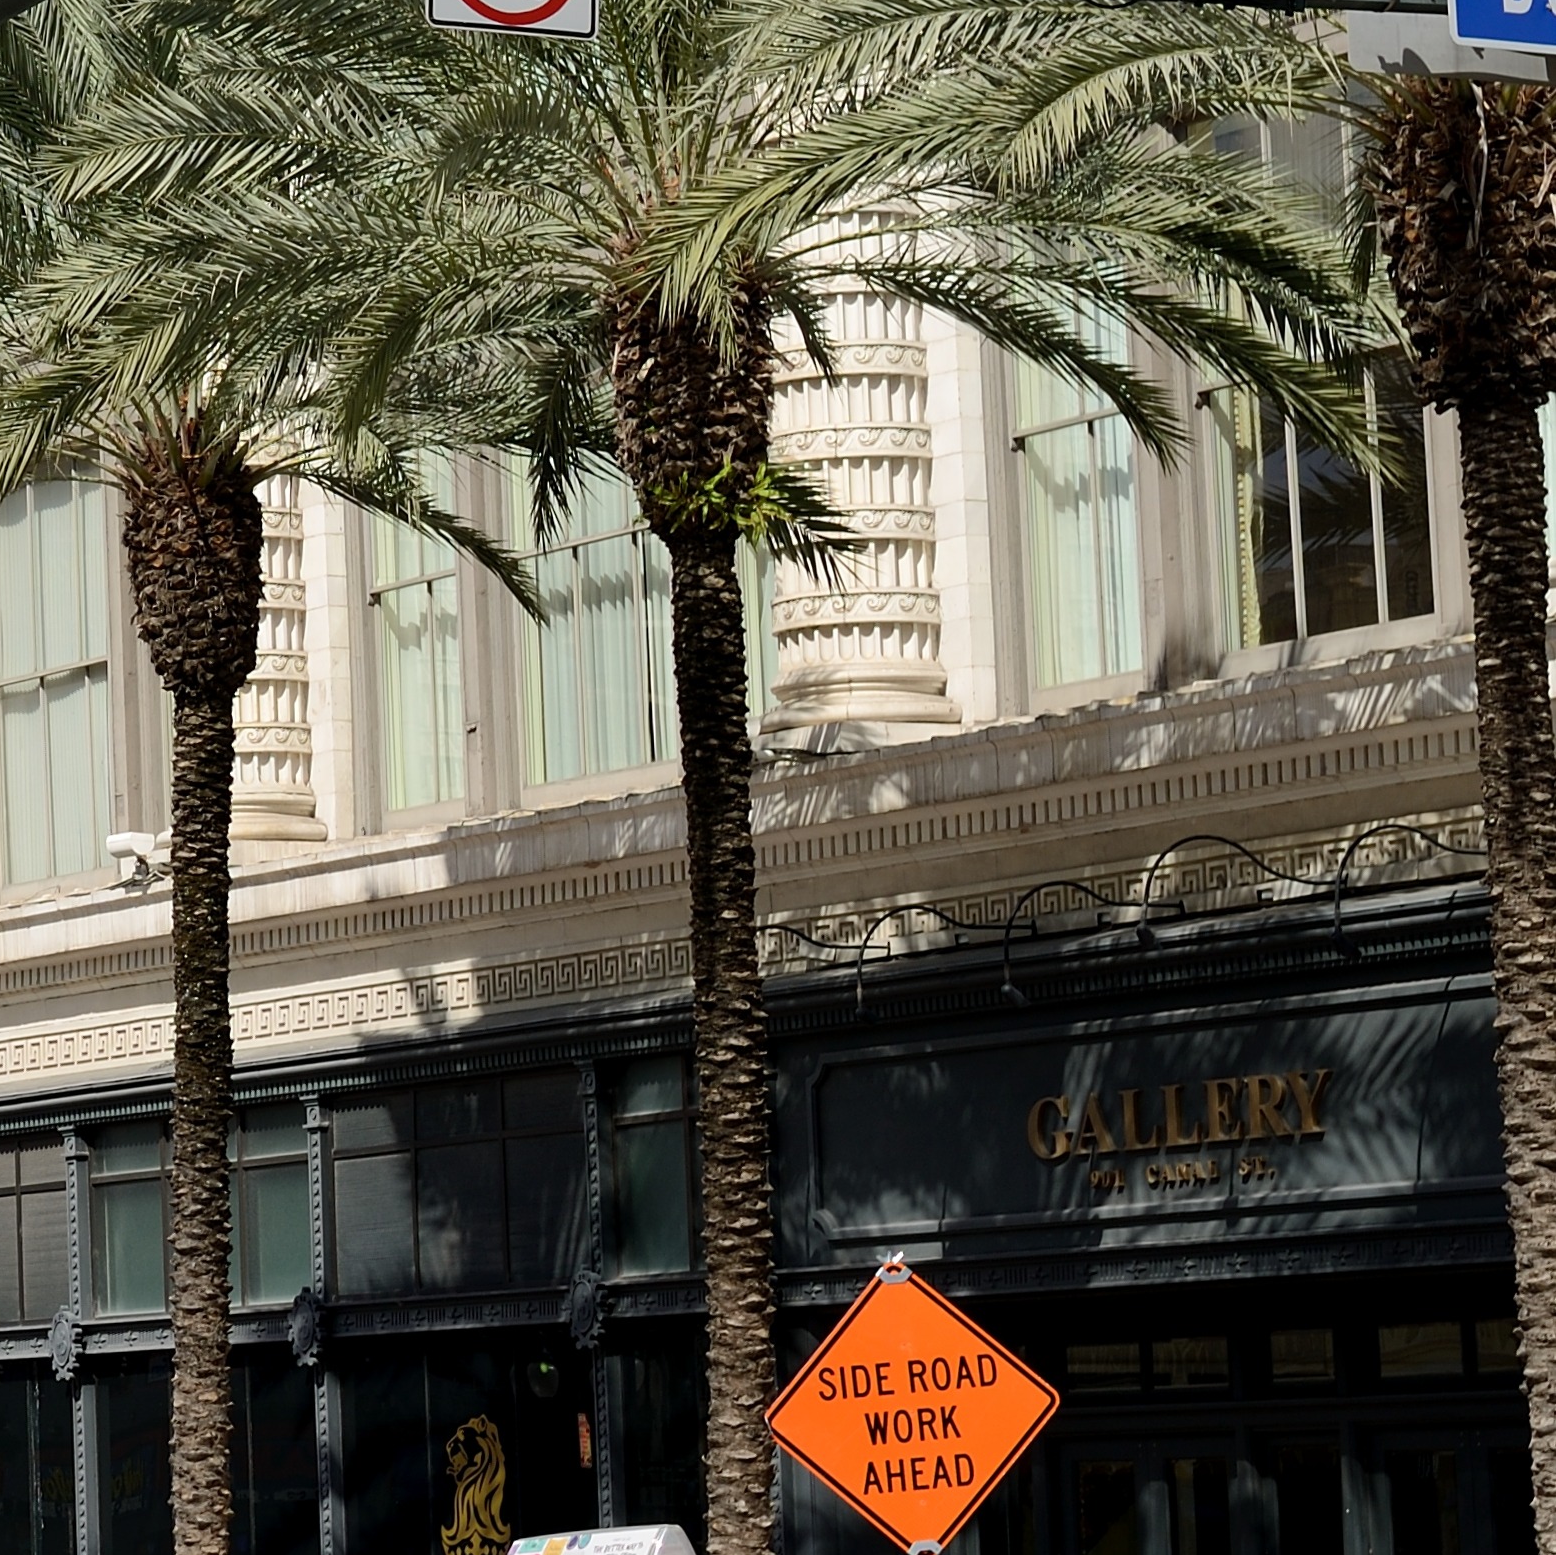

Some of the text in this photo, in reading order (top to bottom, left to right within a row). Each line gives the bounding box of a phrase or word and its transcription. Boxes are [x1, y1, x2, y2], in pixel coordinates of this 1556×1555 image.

[1027, 1068, 1334, 1162] GALLERY
[1090, 1169, 1125, 1190] 901
[1145, 1160, 1220, 1187] CANAL
[818, 1354, 997, 1401] SIDE ROAD
[864, 1405, 961, 1445] WORK
[863, 1453, 975, 1495] AHEAD
